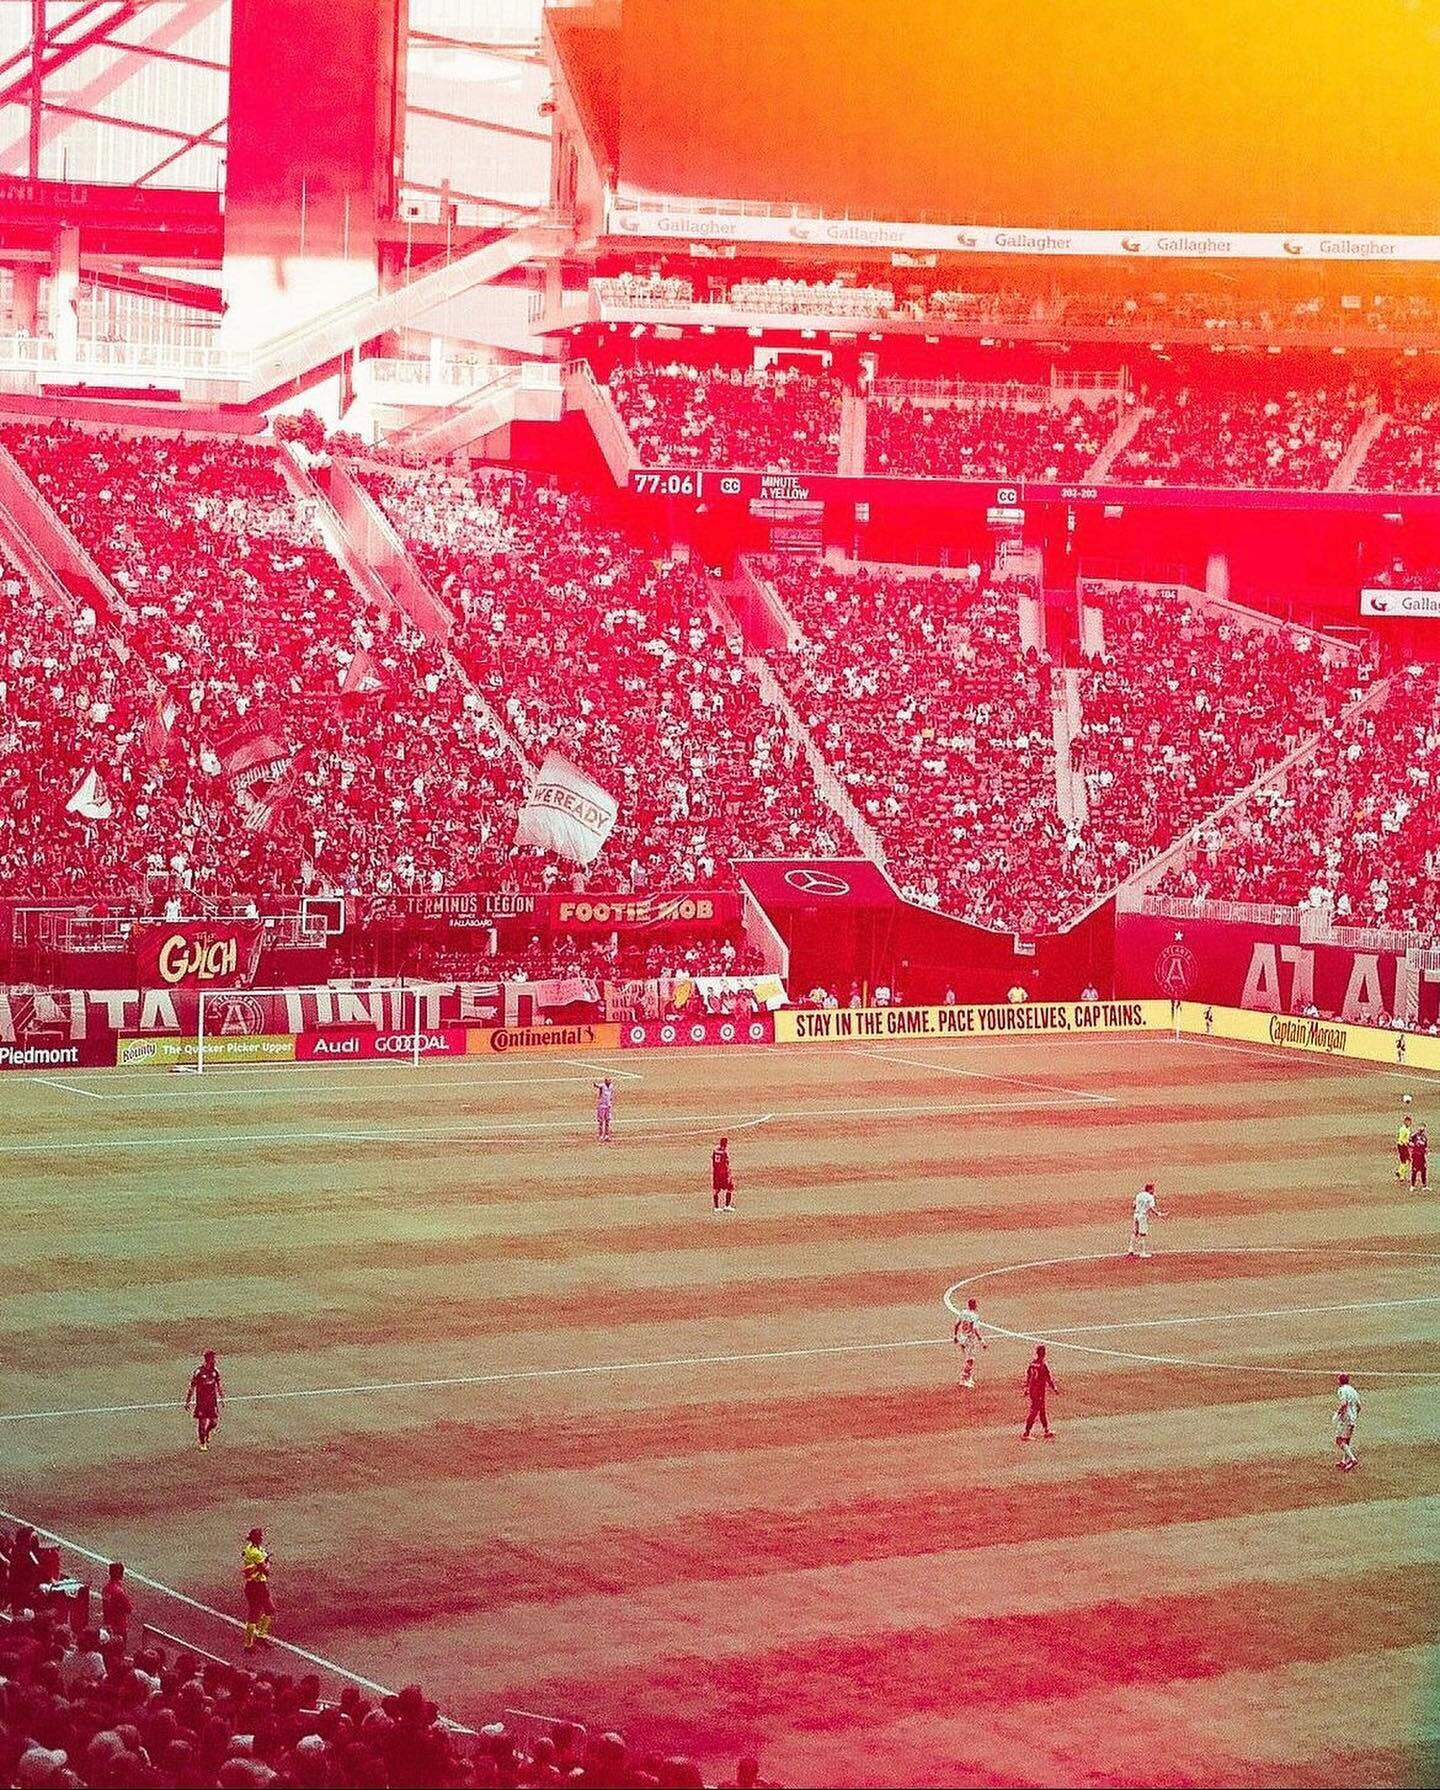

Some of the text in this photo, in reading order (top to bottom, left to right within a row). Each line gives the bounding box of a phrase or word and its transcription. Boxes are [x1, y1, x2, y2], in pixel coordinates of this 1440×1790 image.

[657, 217, 737, 236] Gallagher
[826, 223, 904, 242] Gallagher
[994, 231, 1072, 251] Gallagher
[1156, 236, 1232, 254] Gallagher
[1319, 240, 1398, 256] Gallagher
[634, 474, 693, 495] 77:06
[722, 479, 740, 492] CC
[760, 488, 809, 500] A YELLOW
[999, 490, 1016, 502] CC
[407, 895, 535, 913] TERMINUS LEGION
[559, 899, 714, 922] FOOTIE MOB
[796, 1004, 1147, 1037] STAY IN THE GAME. PACE YOURSELVES, CAPTAINS.
[490, 1026, 582, 1051] Continental
[1269, 1015, 1347, 1052] Captain Morgan
[122, 1043, 157, 1064] Bounty
[163, 1045, 182, 1055] The
[227, 1042, 261, 1053] Picker
[262, 1042, 294, 1054] Upper
[313, 1037, 360, 1054] Audi
[0, 1046, 79, 1065] Piedmont
